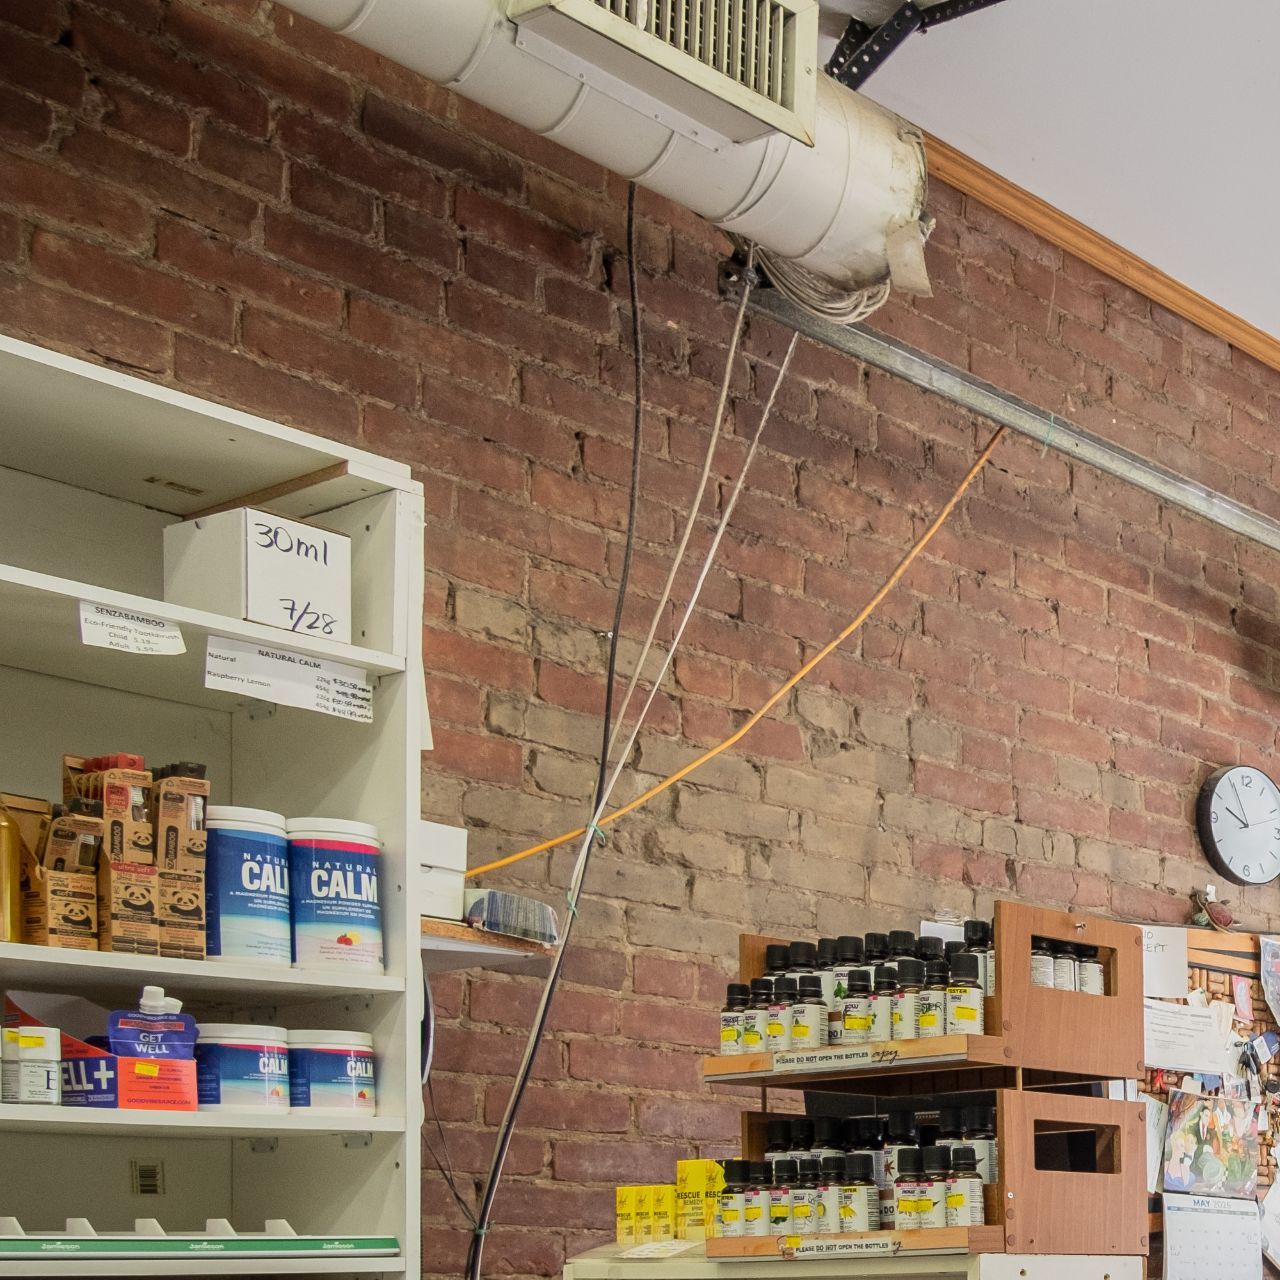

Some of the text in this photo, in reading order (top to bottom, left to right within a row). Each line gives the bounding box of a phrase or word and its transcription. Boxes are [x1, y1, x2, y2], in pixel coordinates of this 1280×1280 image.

[254, 523, 328, 567] 30ml
[94, 605, 166, 628] SENZABAMBOO
[279, 598, 338, 634] 7/28
[84, 617, 133, 634] Eco-Friendly
[108, 632, 129, 642] Child
[207, 651, 237, 663] Natural
[257, 648, 322, 670] NATURAL CALM
[207, 669, 271, 688] Raspberry Lemon
[1241, 774, 1253, 788] 12
[312, 860, 378, 875] NATURAL
[310, 869, 378, 903] CALM
[139, 1032, 164, 1043] GET
[134, 1043, 170, 1054] WELL
[845, 1051, 869, 1059] BOTTLES
[1192, 1199, 1231, 1209] MAY 2025
[41, 1241, 80, 1251] Jamieson
[189, 1241, 225, 1251] Jamieson
[322, 1241, 355, 1249] Jamieson
